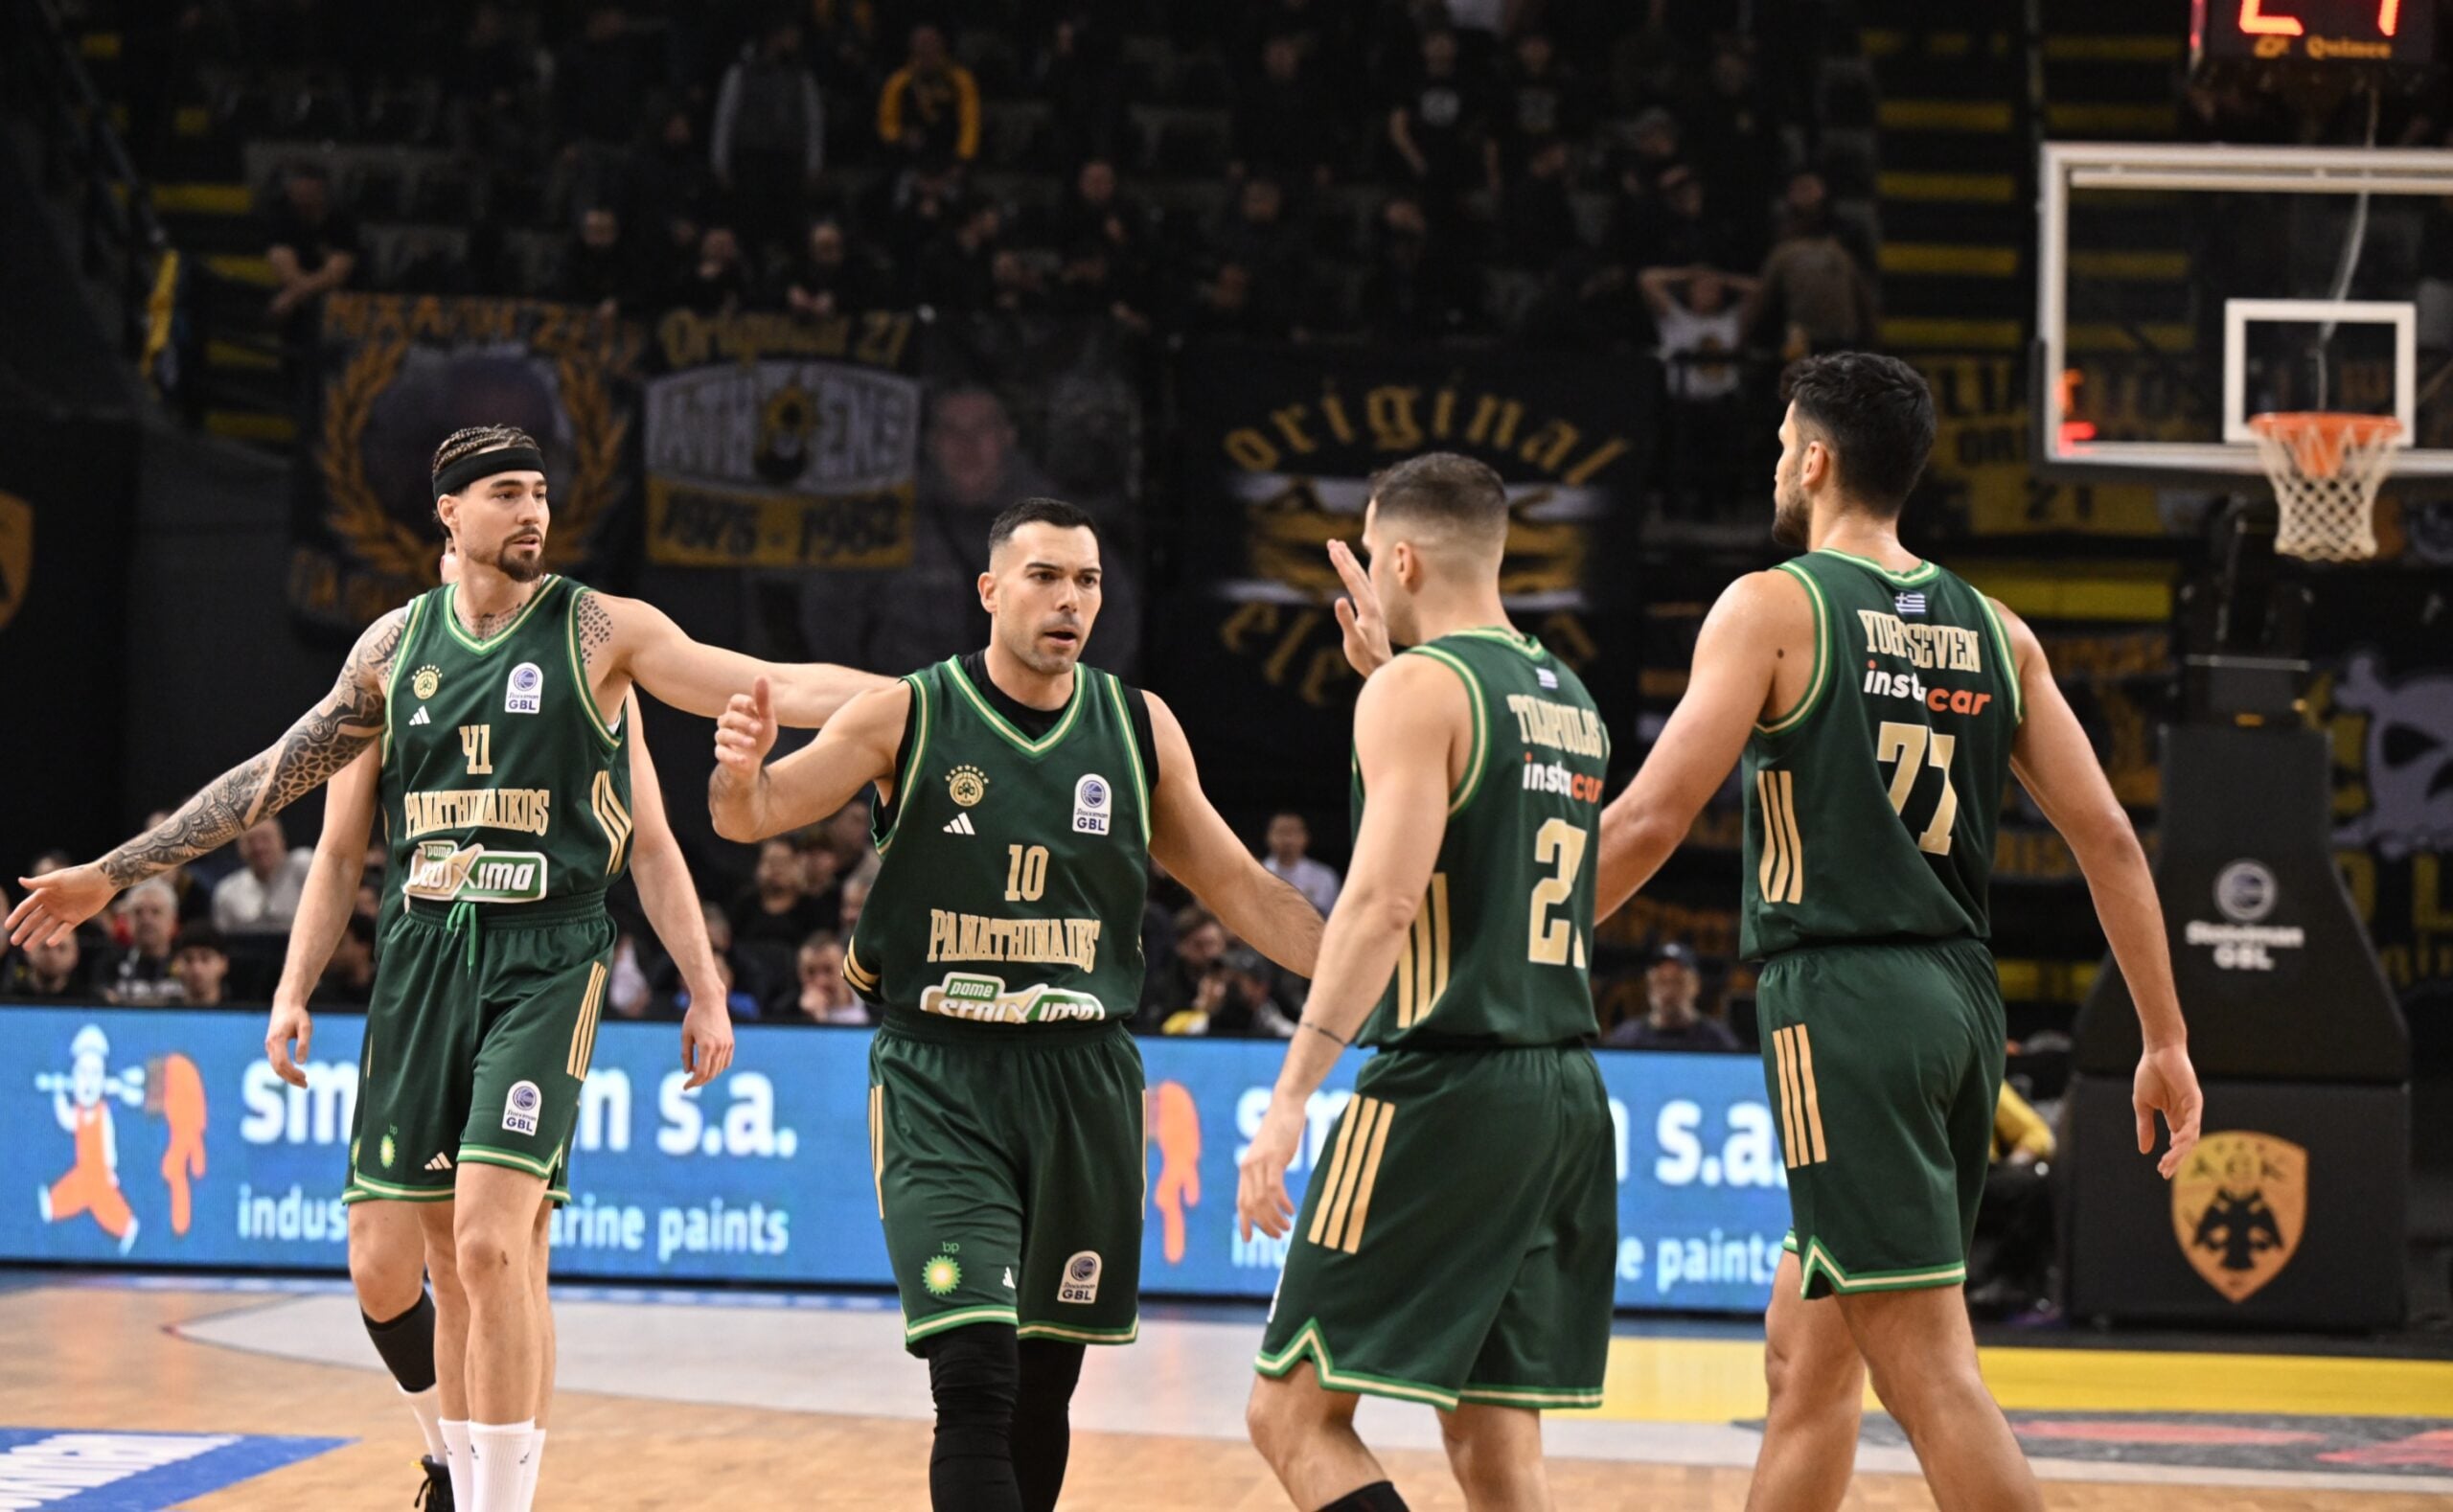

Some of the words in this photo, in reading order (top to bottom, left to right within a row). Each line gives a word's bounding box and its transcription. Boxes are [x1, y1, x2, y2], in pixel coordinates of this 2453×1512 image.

[1222, 368, 1632, 487] original
[508, 699, 537, 711] GBL
[1876, 721, 1959, 856] 77
[1076, 816, 1106, 832] GBL
[1004, 844, 1049, 902] 10
[950, 981, 994, 997] pame
[389, 1124, 399, 1135] bp
[506, 1116, 533, 1133] GBL
[657, 1197, 790, 1264] paints
[942, 1242, 959, 1254] bp
[1062, 1289, 1092, 1301] GBL
